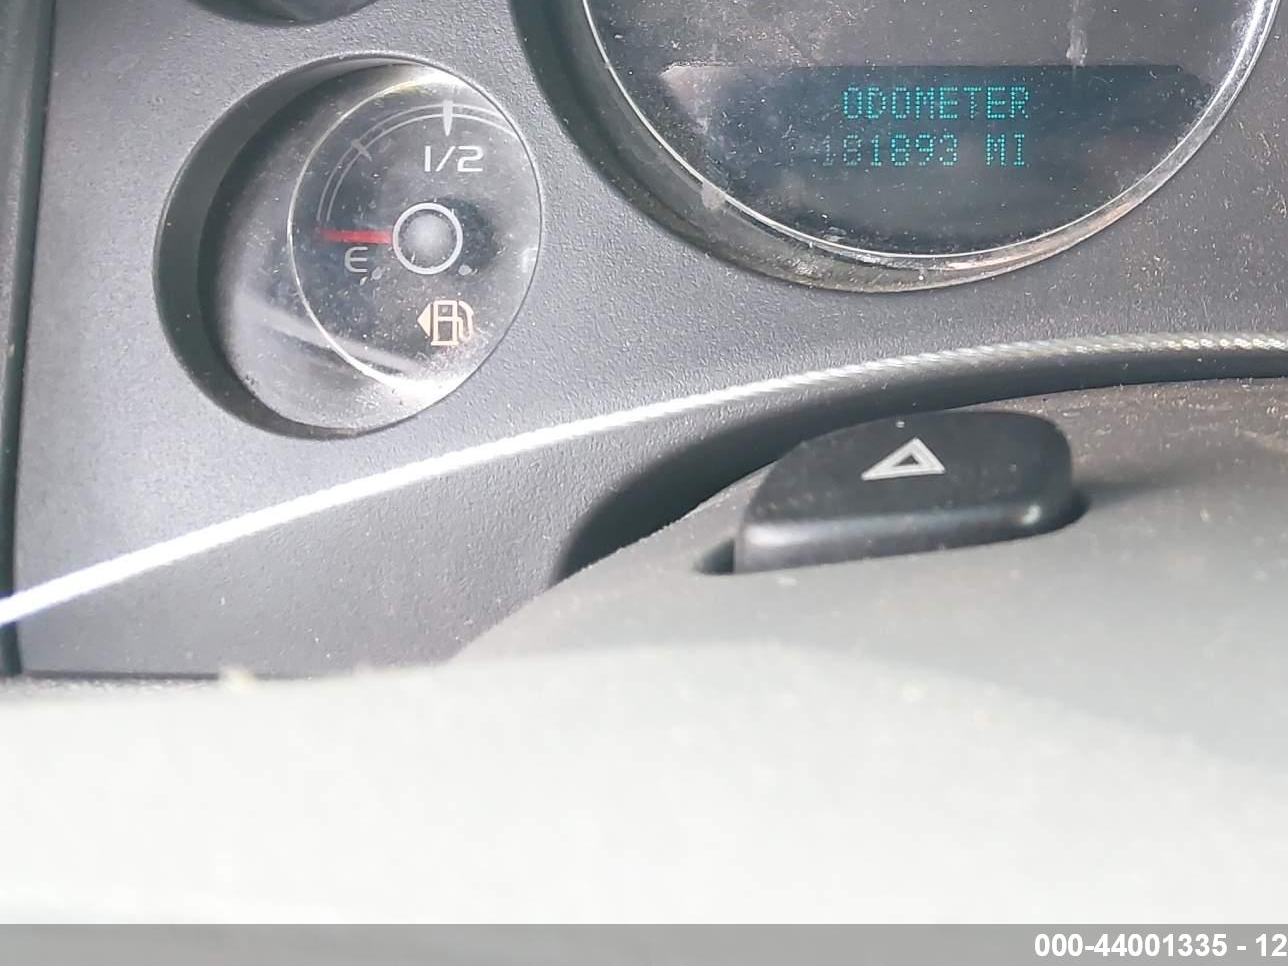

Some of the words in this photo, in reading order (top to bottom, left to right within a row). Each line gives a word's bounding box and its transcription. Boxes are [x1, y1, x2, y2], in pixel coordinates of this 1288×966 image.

[842, 86, 1030, 119] ODOMETER
[423, 144, 484, 173] 1/2
[985, 134, 1026, 166] MI
[344, 246, 369, 273] E
